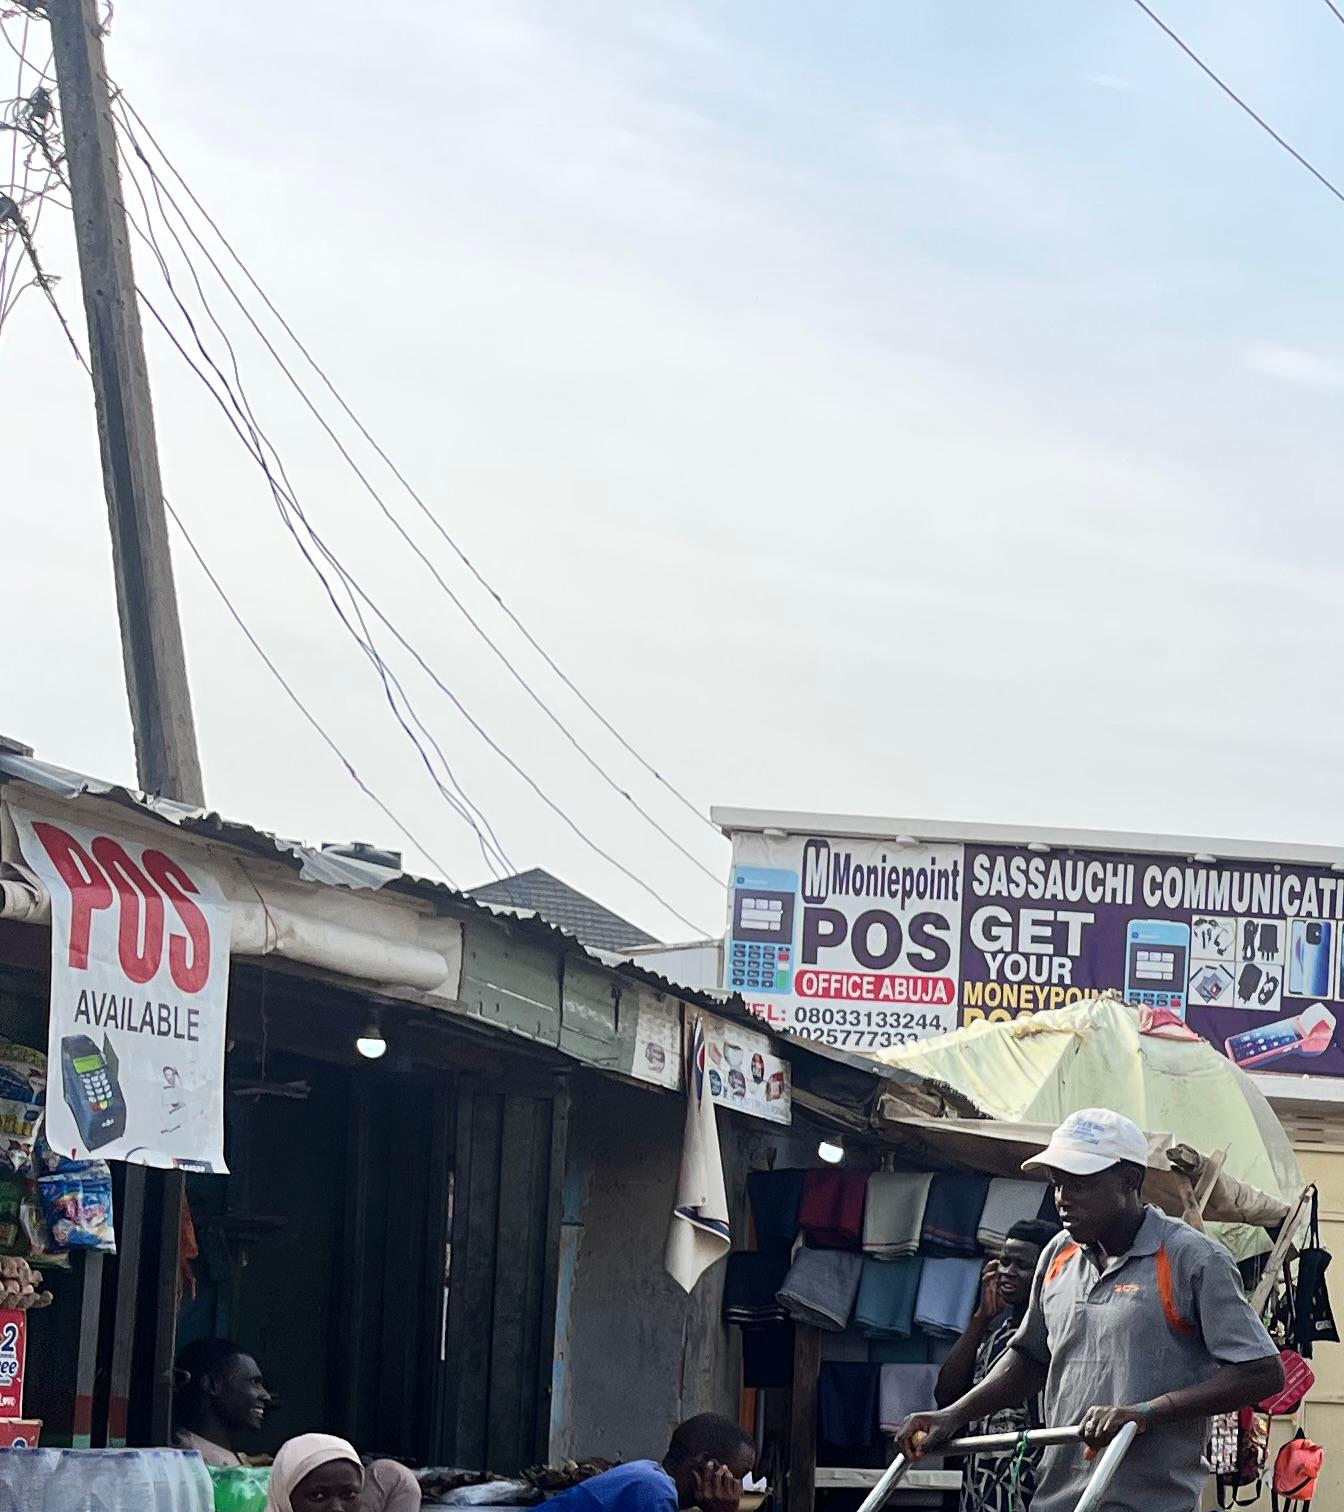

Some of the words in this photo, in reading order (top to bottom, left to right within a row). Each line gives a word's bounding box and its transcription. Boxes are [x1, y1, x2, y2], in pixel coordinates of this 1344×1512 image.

[832, 852, 959, 910] Moniepoint
[972, 853, 1134, 905] SASSAUCHI
[30, 820, 210, 993] POS
[969, 905, 1095, 957] GET
[801, 906, 951, 973] POS
[802, 972, 876, 999] OFFICE
[880, 977, 948, 1001] ABUJA
[984, 953, 1073, 985] YOUR
[74, 989, 200, 1042] AVAILABLE
[747, 1002, 786, 1021] EL:
[795, 1006, 948, 1033] 08033133244,
